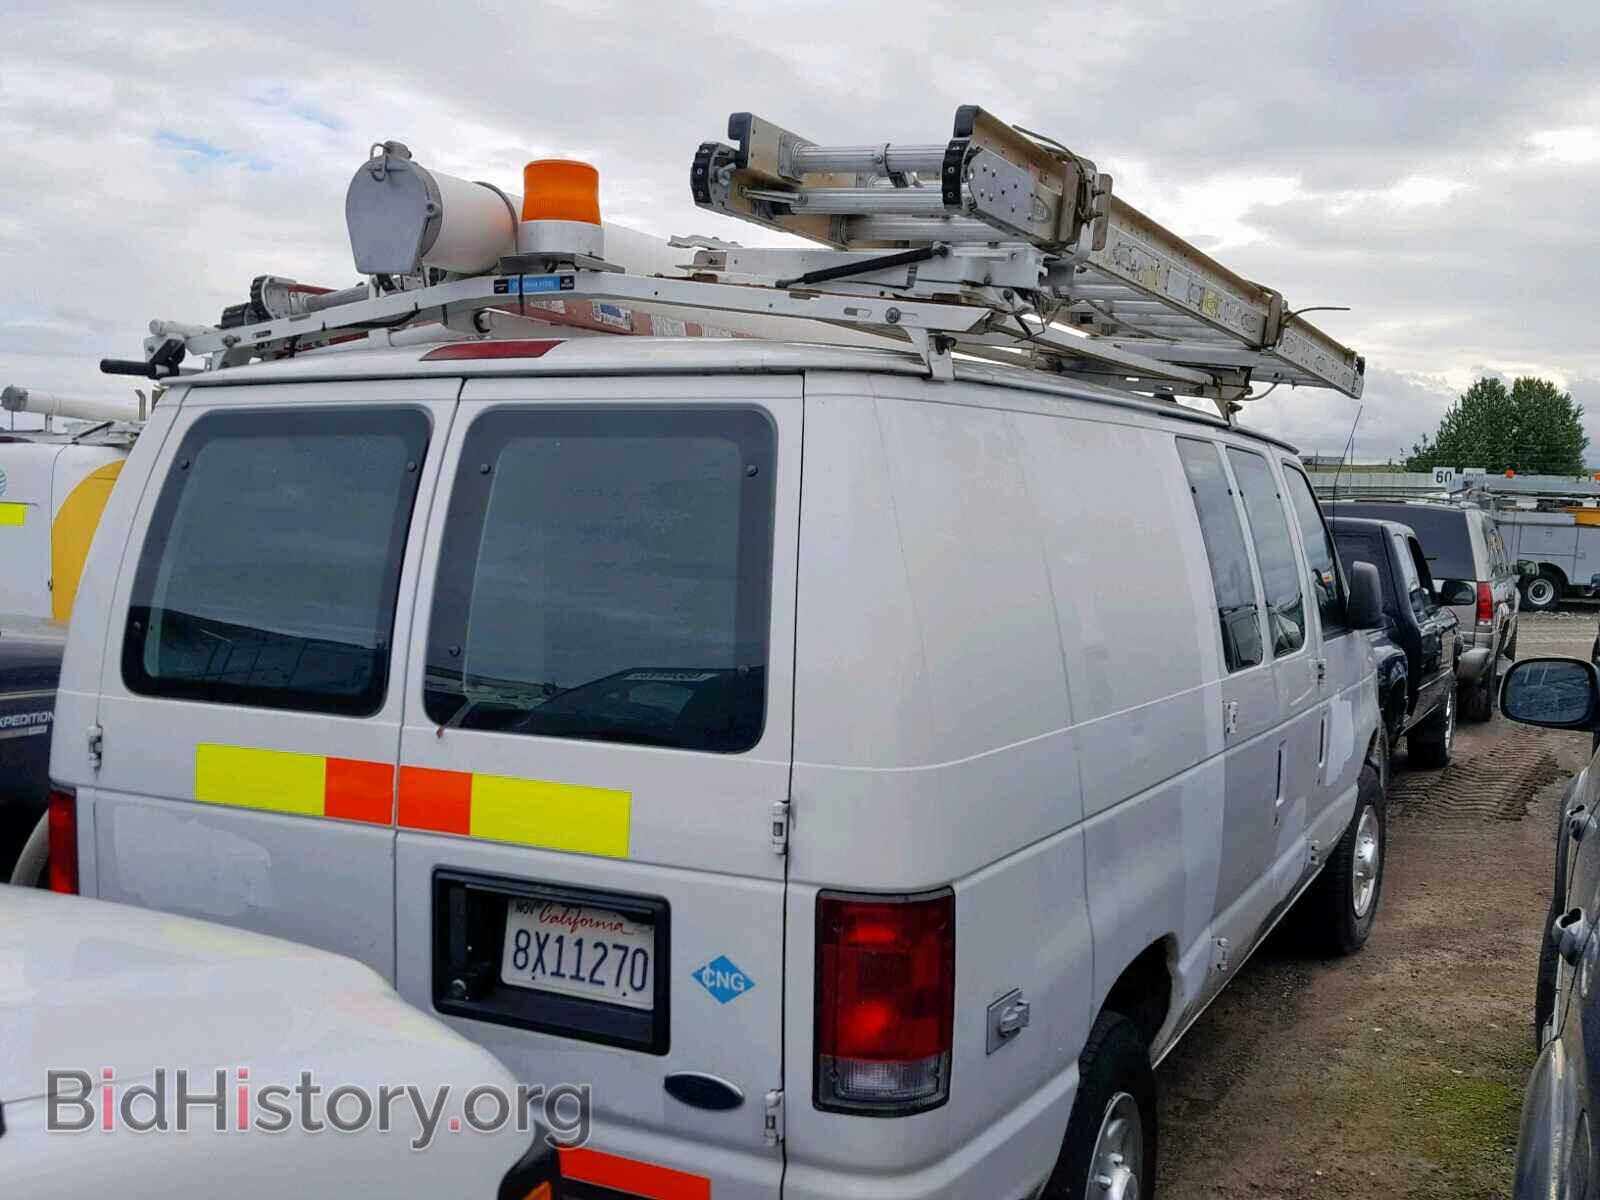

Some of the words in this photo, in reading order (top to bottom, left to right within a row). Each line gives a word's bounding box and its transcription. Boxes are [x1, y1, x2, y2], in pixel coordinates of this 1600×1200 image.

[1436, 470, 1452, 484] 60
[539, 902, 634, 935] California
[513, 928, 649, 992] 8X11270
[702, 966, 745, 992] CNG
